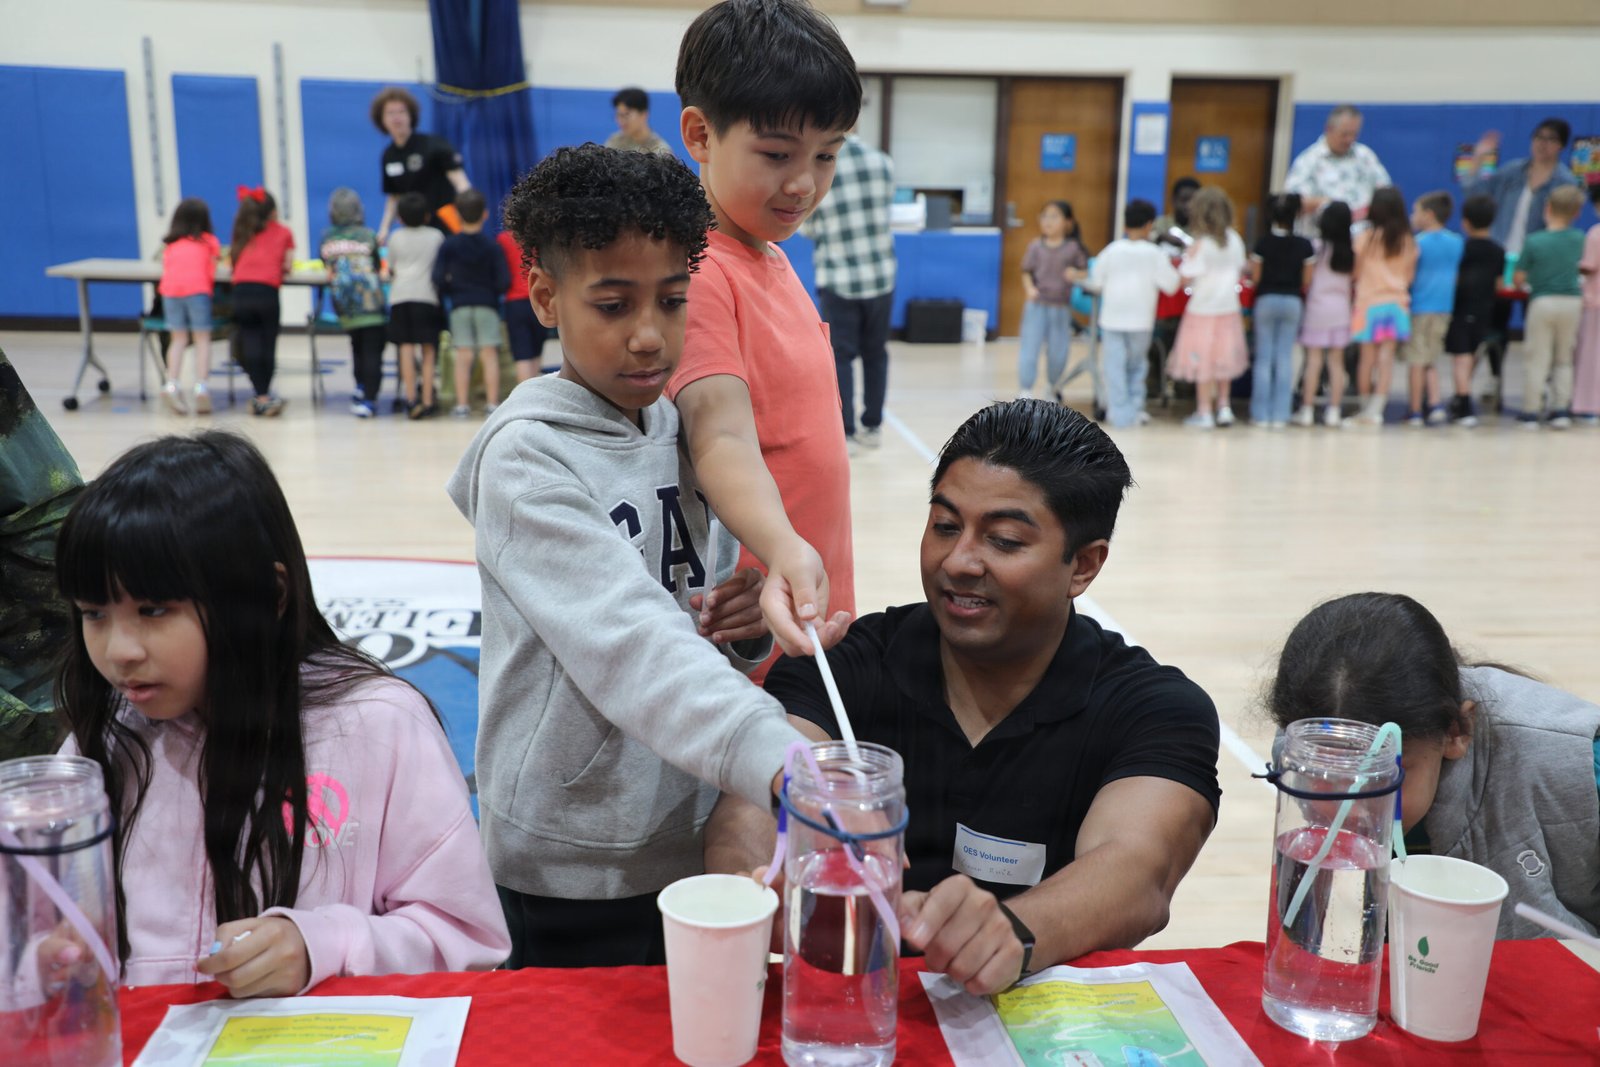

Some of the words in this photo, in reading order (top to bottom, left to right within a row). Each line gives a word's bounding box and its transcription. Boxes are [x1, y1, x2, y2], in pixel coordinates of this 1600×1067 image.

[963, 845, 978, 857] OES
[979, 851, 1018, 865] Volunteer
[1410, 961, 1436, 973] Friends
[1419, 960, 1439, 968] Good
